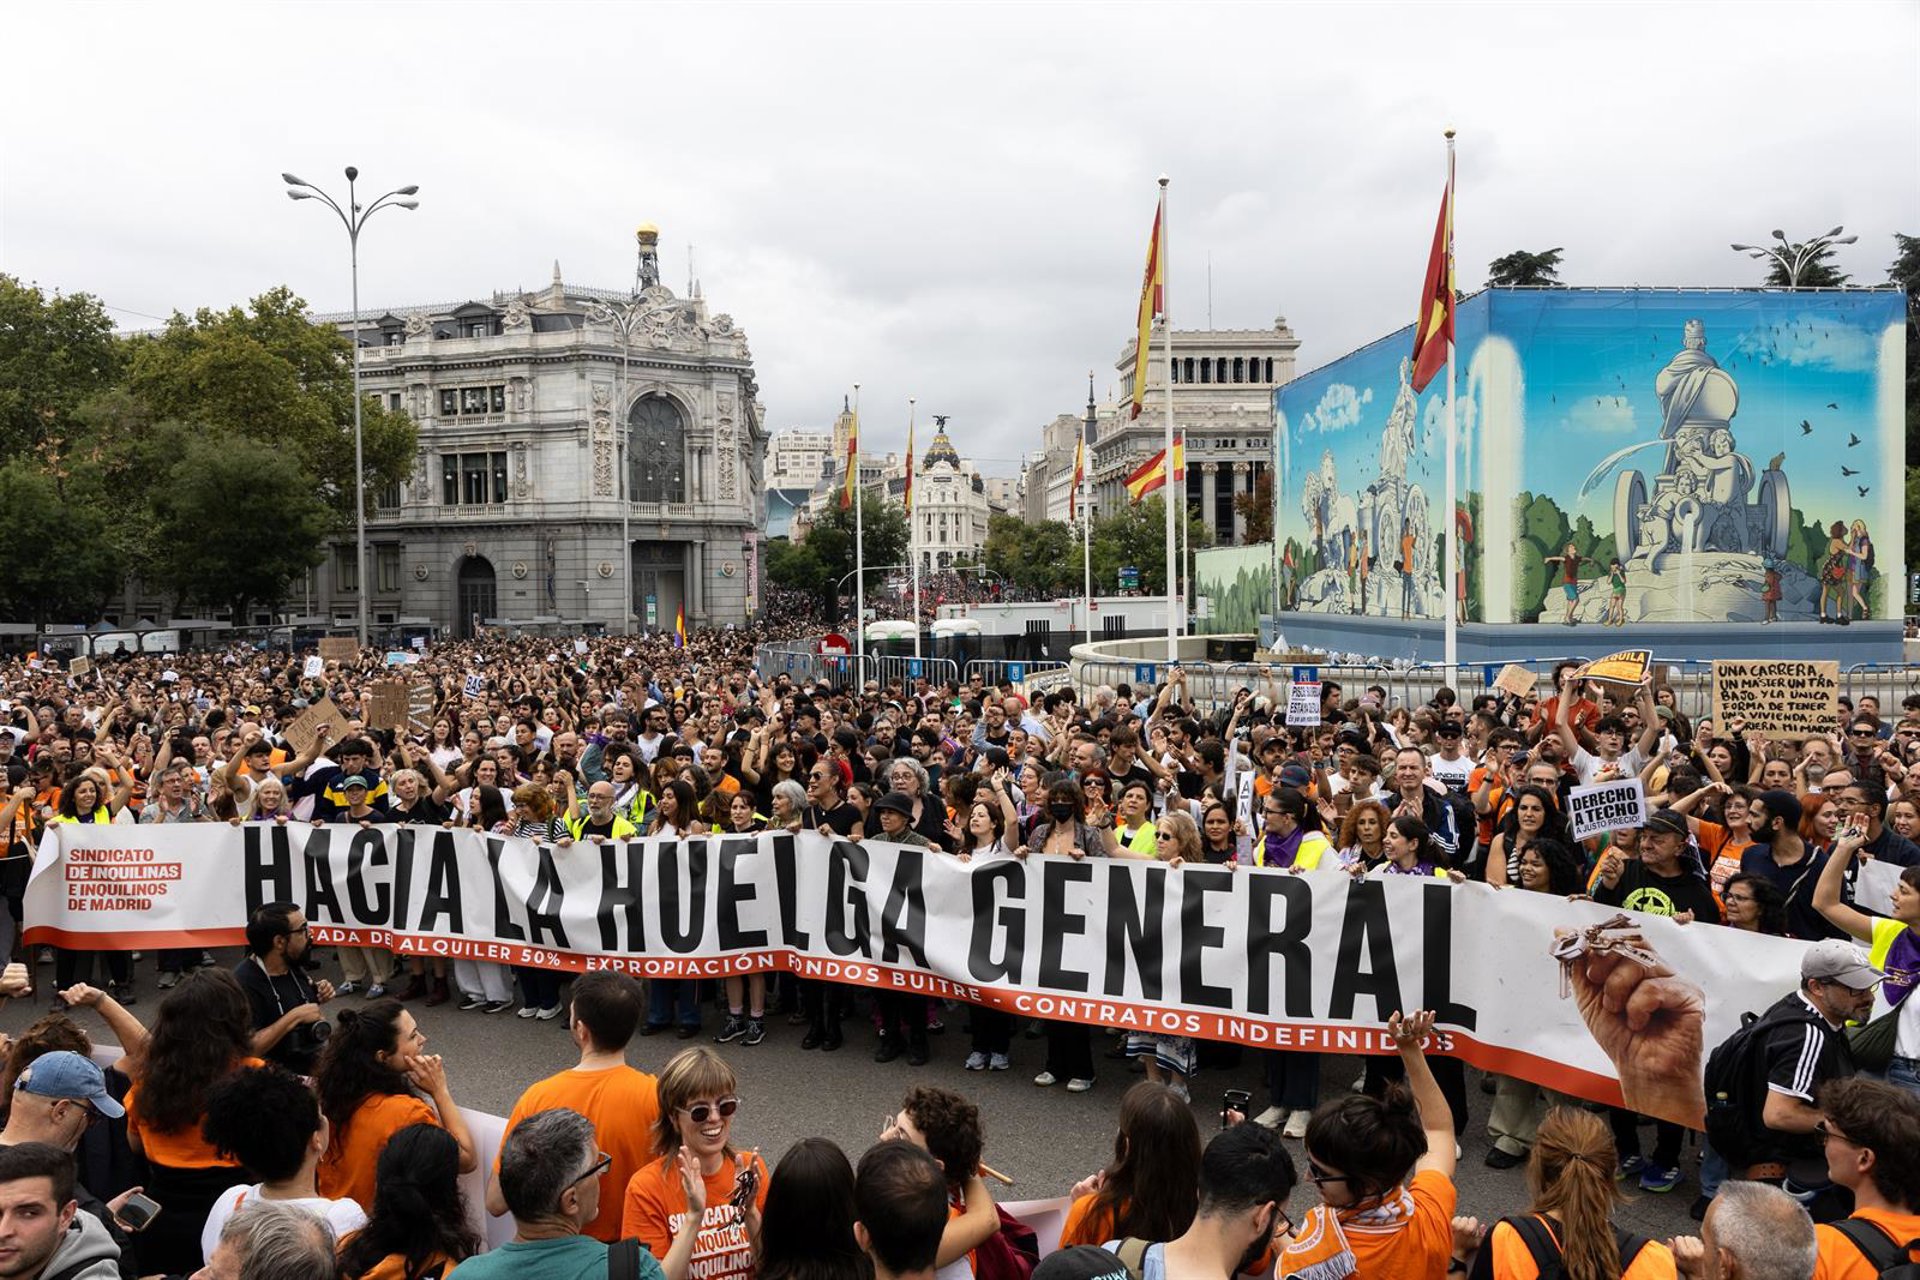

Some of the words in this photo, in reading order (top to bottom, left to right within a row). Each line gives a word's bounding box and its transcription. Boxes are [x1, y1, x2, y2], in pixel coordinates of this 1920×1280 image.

[1718, 665, 1747, 677] UNA
[1719, 679, 1738, 690] UN
[1787, 678, 1806, 689] UN
[1760, 690, 1769, 699] Y
[1769, 690, 1785, 699] LA
[1722, 701, 1765, 711] FORMA
[1768, 702, 1784, 711] DE
[1787, 702, 1826, 711] TENER
[1816, 714, 1837, 724] QUE
[1782, 723, 1798, 732] MI
[1432, 772, 1466, 780] UNDER
[1571, 786, 1637, 812] DERECHO
[1575, 811, 1585, 827] A
[1585, 801, 1639, 823] TECHO
[1576, 827, 1584, 835] A
[1582, 820, 1607, 833] JUSTO
[1607, 815, 1641, 827] PRECIO!
[69, 848, 155, 862] SINDICATO
[69, 866, 90, 879] DE
[91, 865, 179, 881] INQUILINAS
[68, 883, 77, 896] E
[80, 882, 168, 897] INQUILINOS
[67, 898, 87, 911] DE
[89, 898, 152, 911] MADRID
[243, 825, 465, 935] HACIA
[486, 837, 572, 949] LA
[596, 835, 932, 970] HUELGA
[967, 859, 1477, 1033] GENERAL
[399, 937, 511, 960] ALQUILER
[520, 949, 561, 967] 50%
[586, 951, 775, 975] EXPROPIACIÓN
[787, 953, 880, 983] FONDOS
[892, 972, 983, 1002] BUITRE
[1015, 995, 1201, 1033] CONTRATOS
